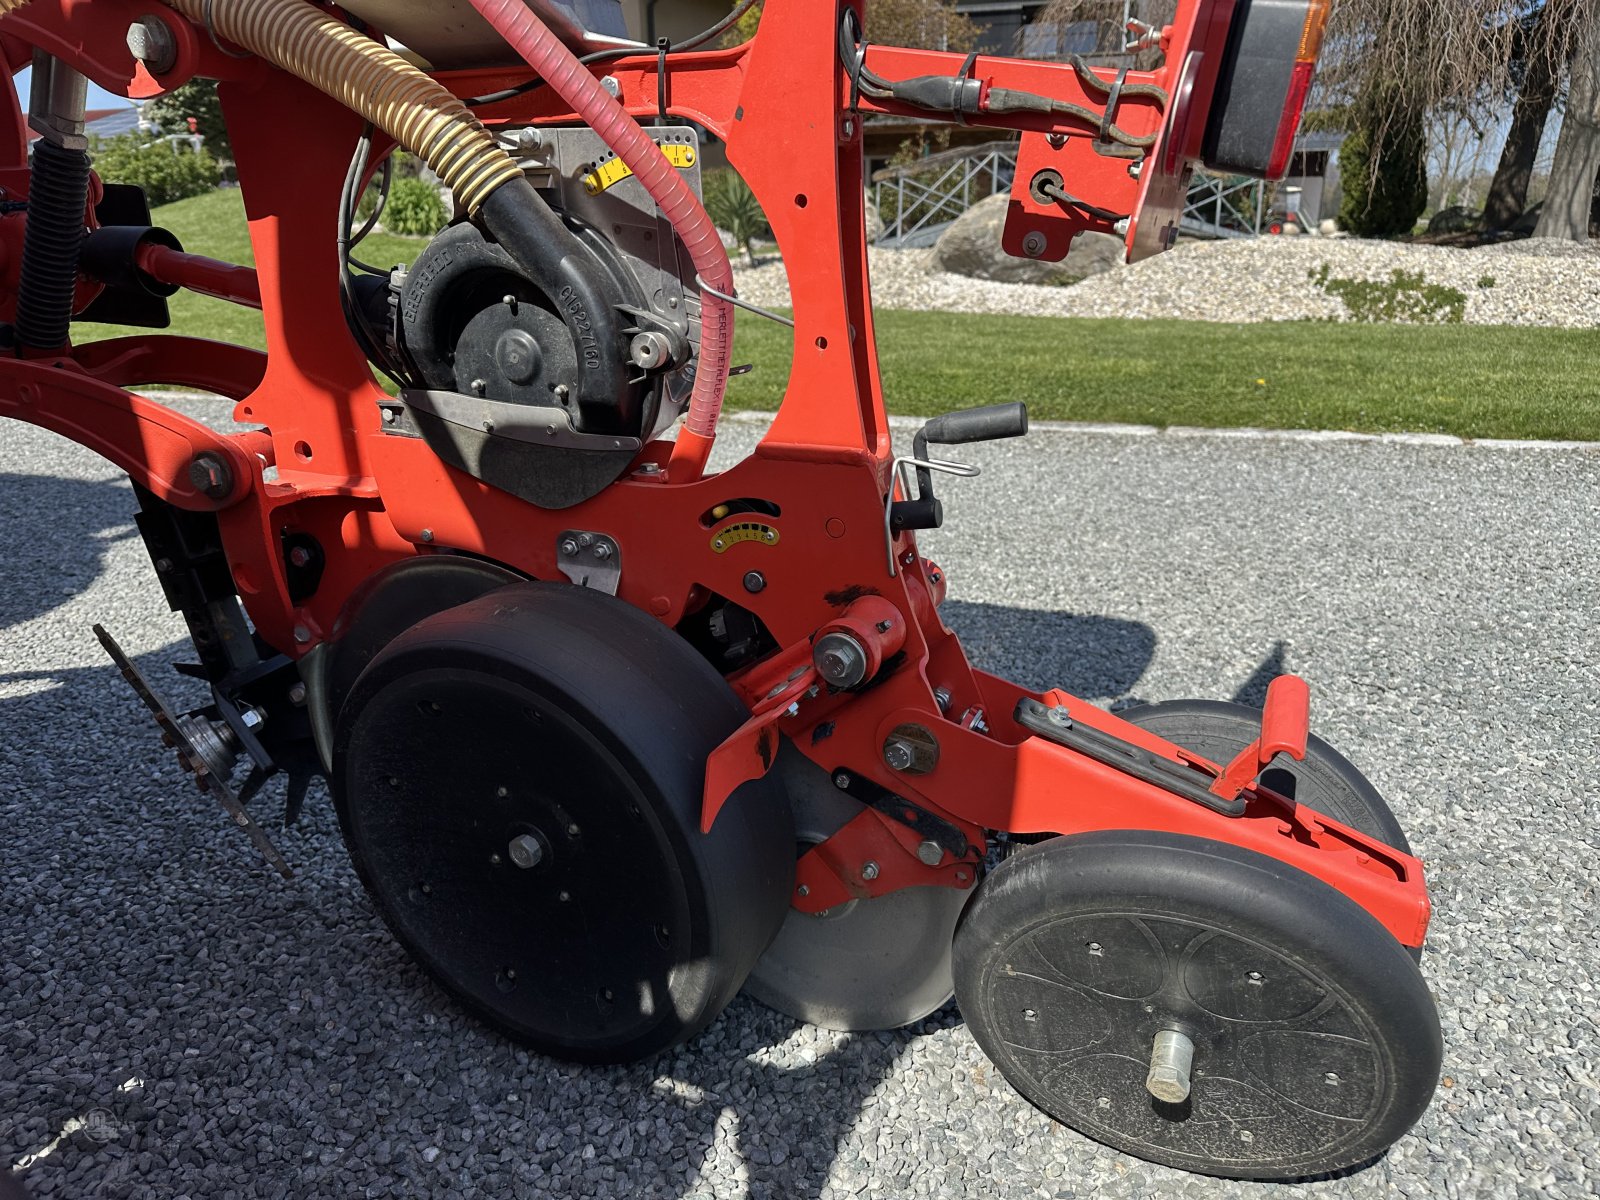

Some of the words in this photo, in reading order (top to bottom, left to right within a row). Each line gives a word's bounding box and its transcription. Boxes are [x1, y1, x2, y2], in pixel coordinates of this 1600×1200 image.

[403, 248, 454, 324] GASPARDO
[718, 307, 727, 350] MERLETT
[713, 350, 727, 400] METALFLEX
